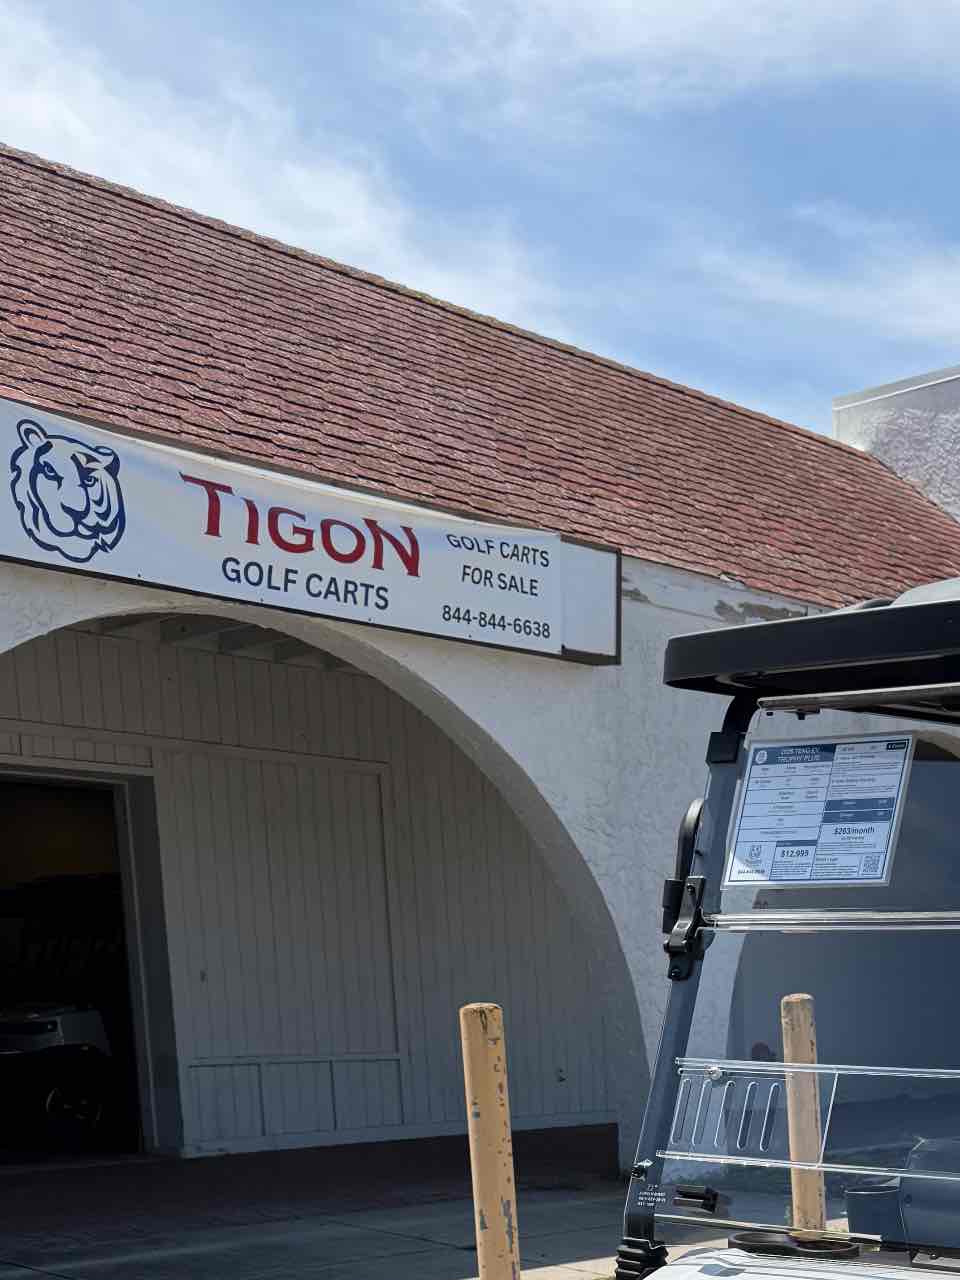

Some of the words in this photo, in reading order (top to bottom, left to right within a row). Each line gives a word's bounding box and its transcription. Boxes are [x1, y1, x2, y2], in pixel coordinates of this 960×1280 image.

[179, 472, 421, 577] TIGON
[445, 532, 496, 559] GOLF
[500, 540, 551, 569] CARTS
[221, 555, 300, 594] GOLF
[304, 571, 390, 612] CARTS
[460, 564, 494, 589] FOR
[496, 571, 540, 597] SALE
[442, 605, 551, 638] 844-844-6638
